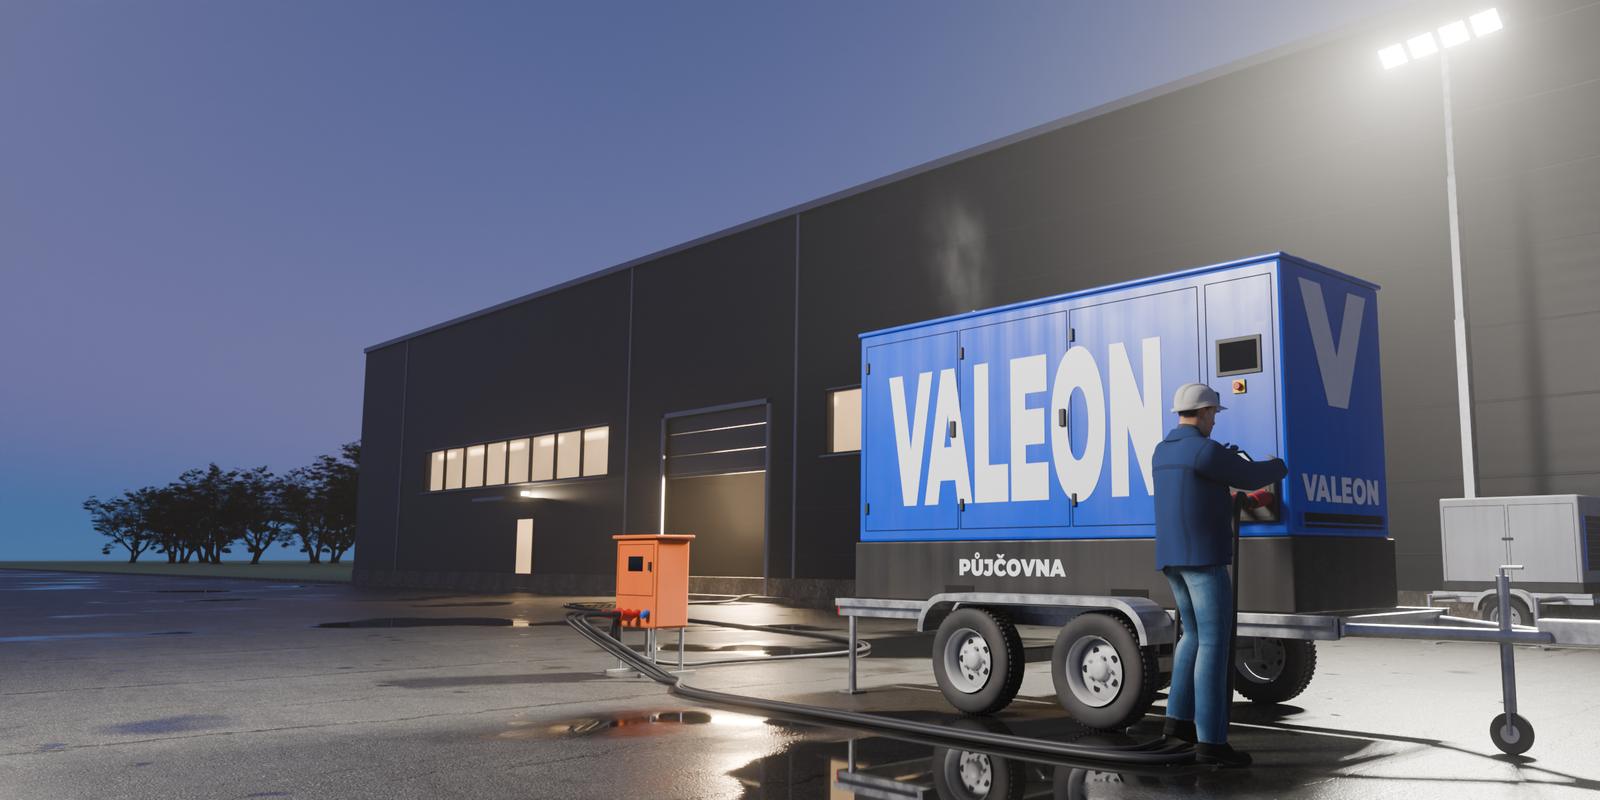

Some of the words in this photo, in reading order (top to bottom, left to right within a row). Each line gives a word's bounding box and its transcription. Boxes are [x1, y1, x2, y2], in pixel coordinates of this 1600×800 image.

[1299, 276, 1366, 409] V
[889, 336, 1163, 507] VALEON
[1302, 473, 1380, 506] VALEON
[958, 552, 1066, 577] PŮJČOVNA
